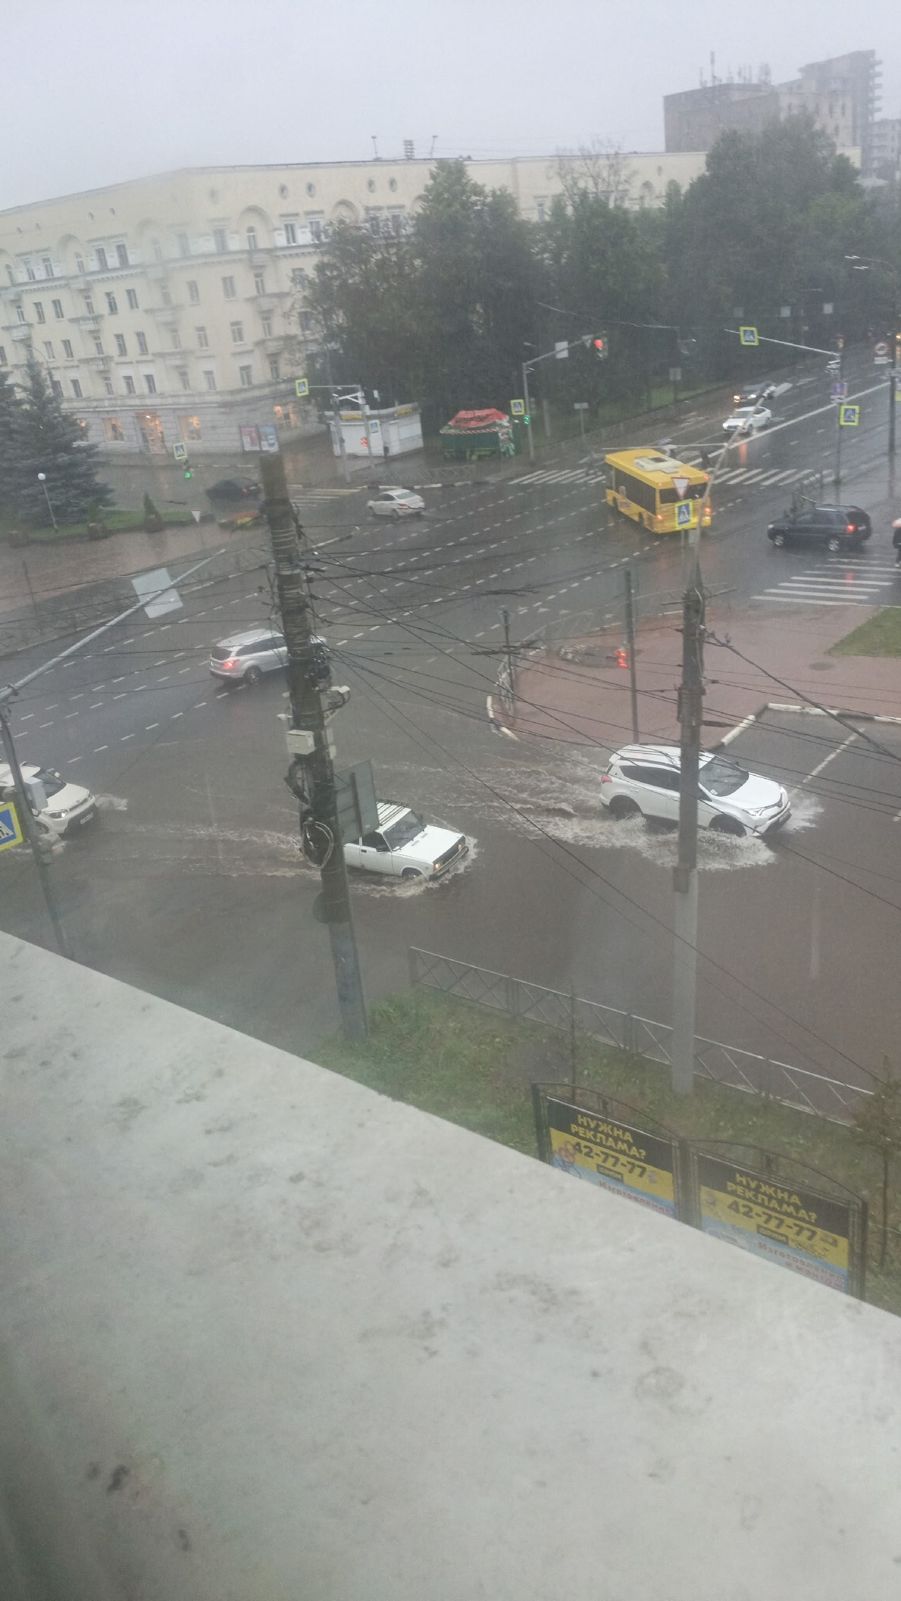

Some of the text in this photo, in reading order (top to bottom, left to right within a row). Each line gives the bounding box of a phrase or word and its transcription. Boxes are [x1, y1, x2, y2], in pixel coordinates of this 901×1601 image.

[570, 1124, 647, 1159] РЕКЛАМА?
[577, 1115, 633, 1143] НУЖНА
[574, 1142, 647, 1178] 42-77-77
[726, 1181, 817, 1224] РЕКЛАМА?
[735, 1173, 802, 1206] НУЖНА
[727, 1200, 817, 1242] 42-77-77
